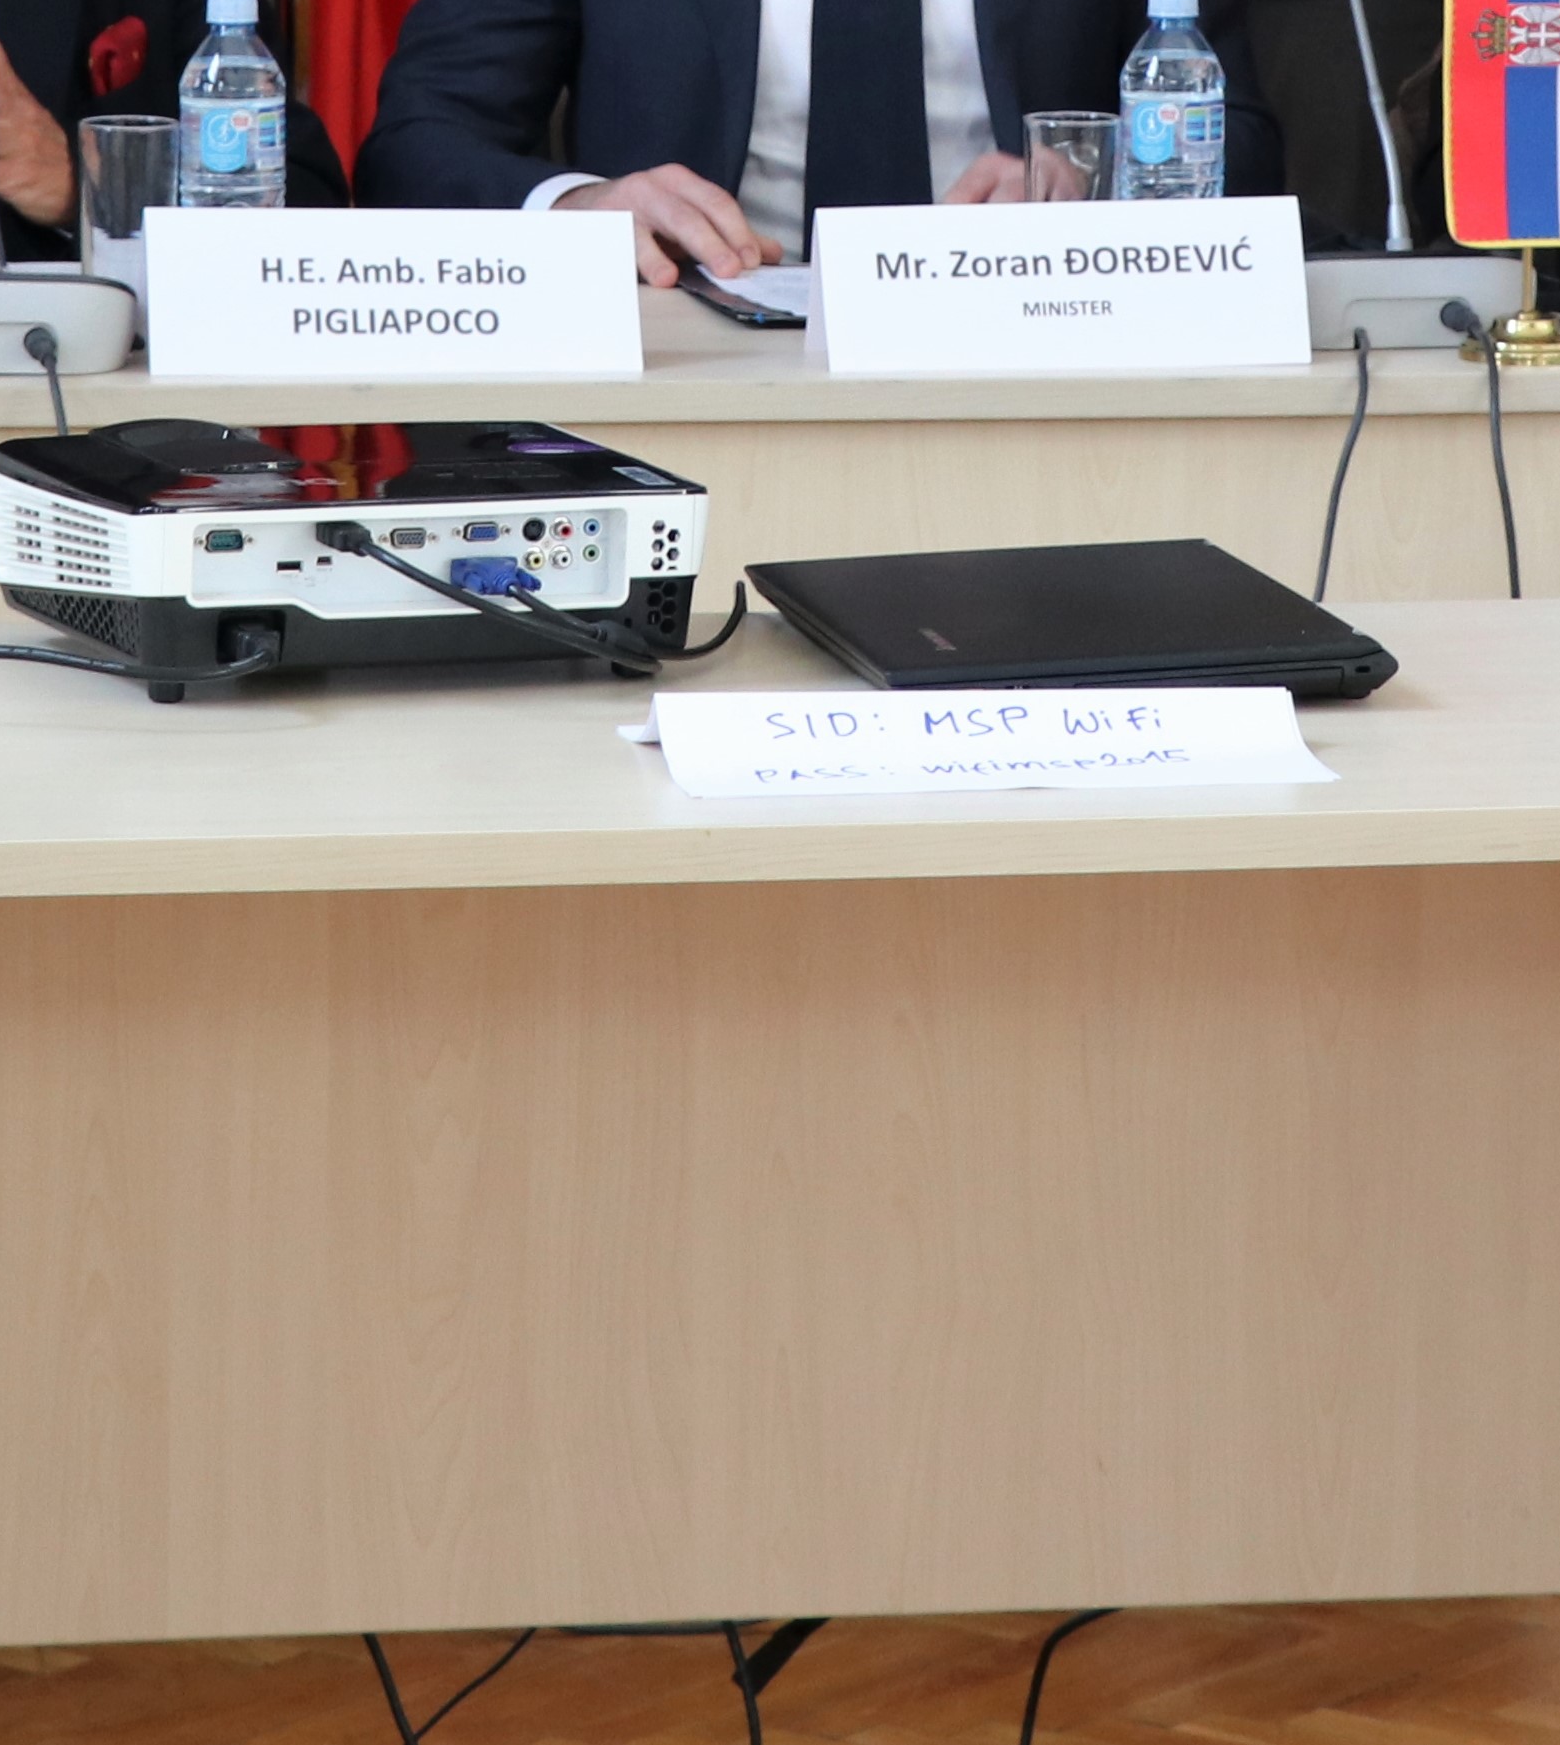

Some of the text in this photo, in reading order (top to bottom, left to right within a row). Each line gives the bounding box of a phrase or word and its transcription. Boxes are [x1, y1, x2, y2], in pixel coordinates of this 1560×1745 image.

[260, 257, 527, 285] H.E. Amb. Fabio
[875, 236, 1254, 281] Mr. Zoran ĐORĐEVIĆ
[292, 308, 500, 336] PIGLIAPOCO
[1022, 299, 1113, 317] MINISTER
[765, 712, 885, 740] SID:
[923, 705, 1029, 737] MSP
